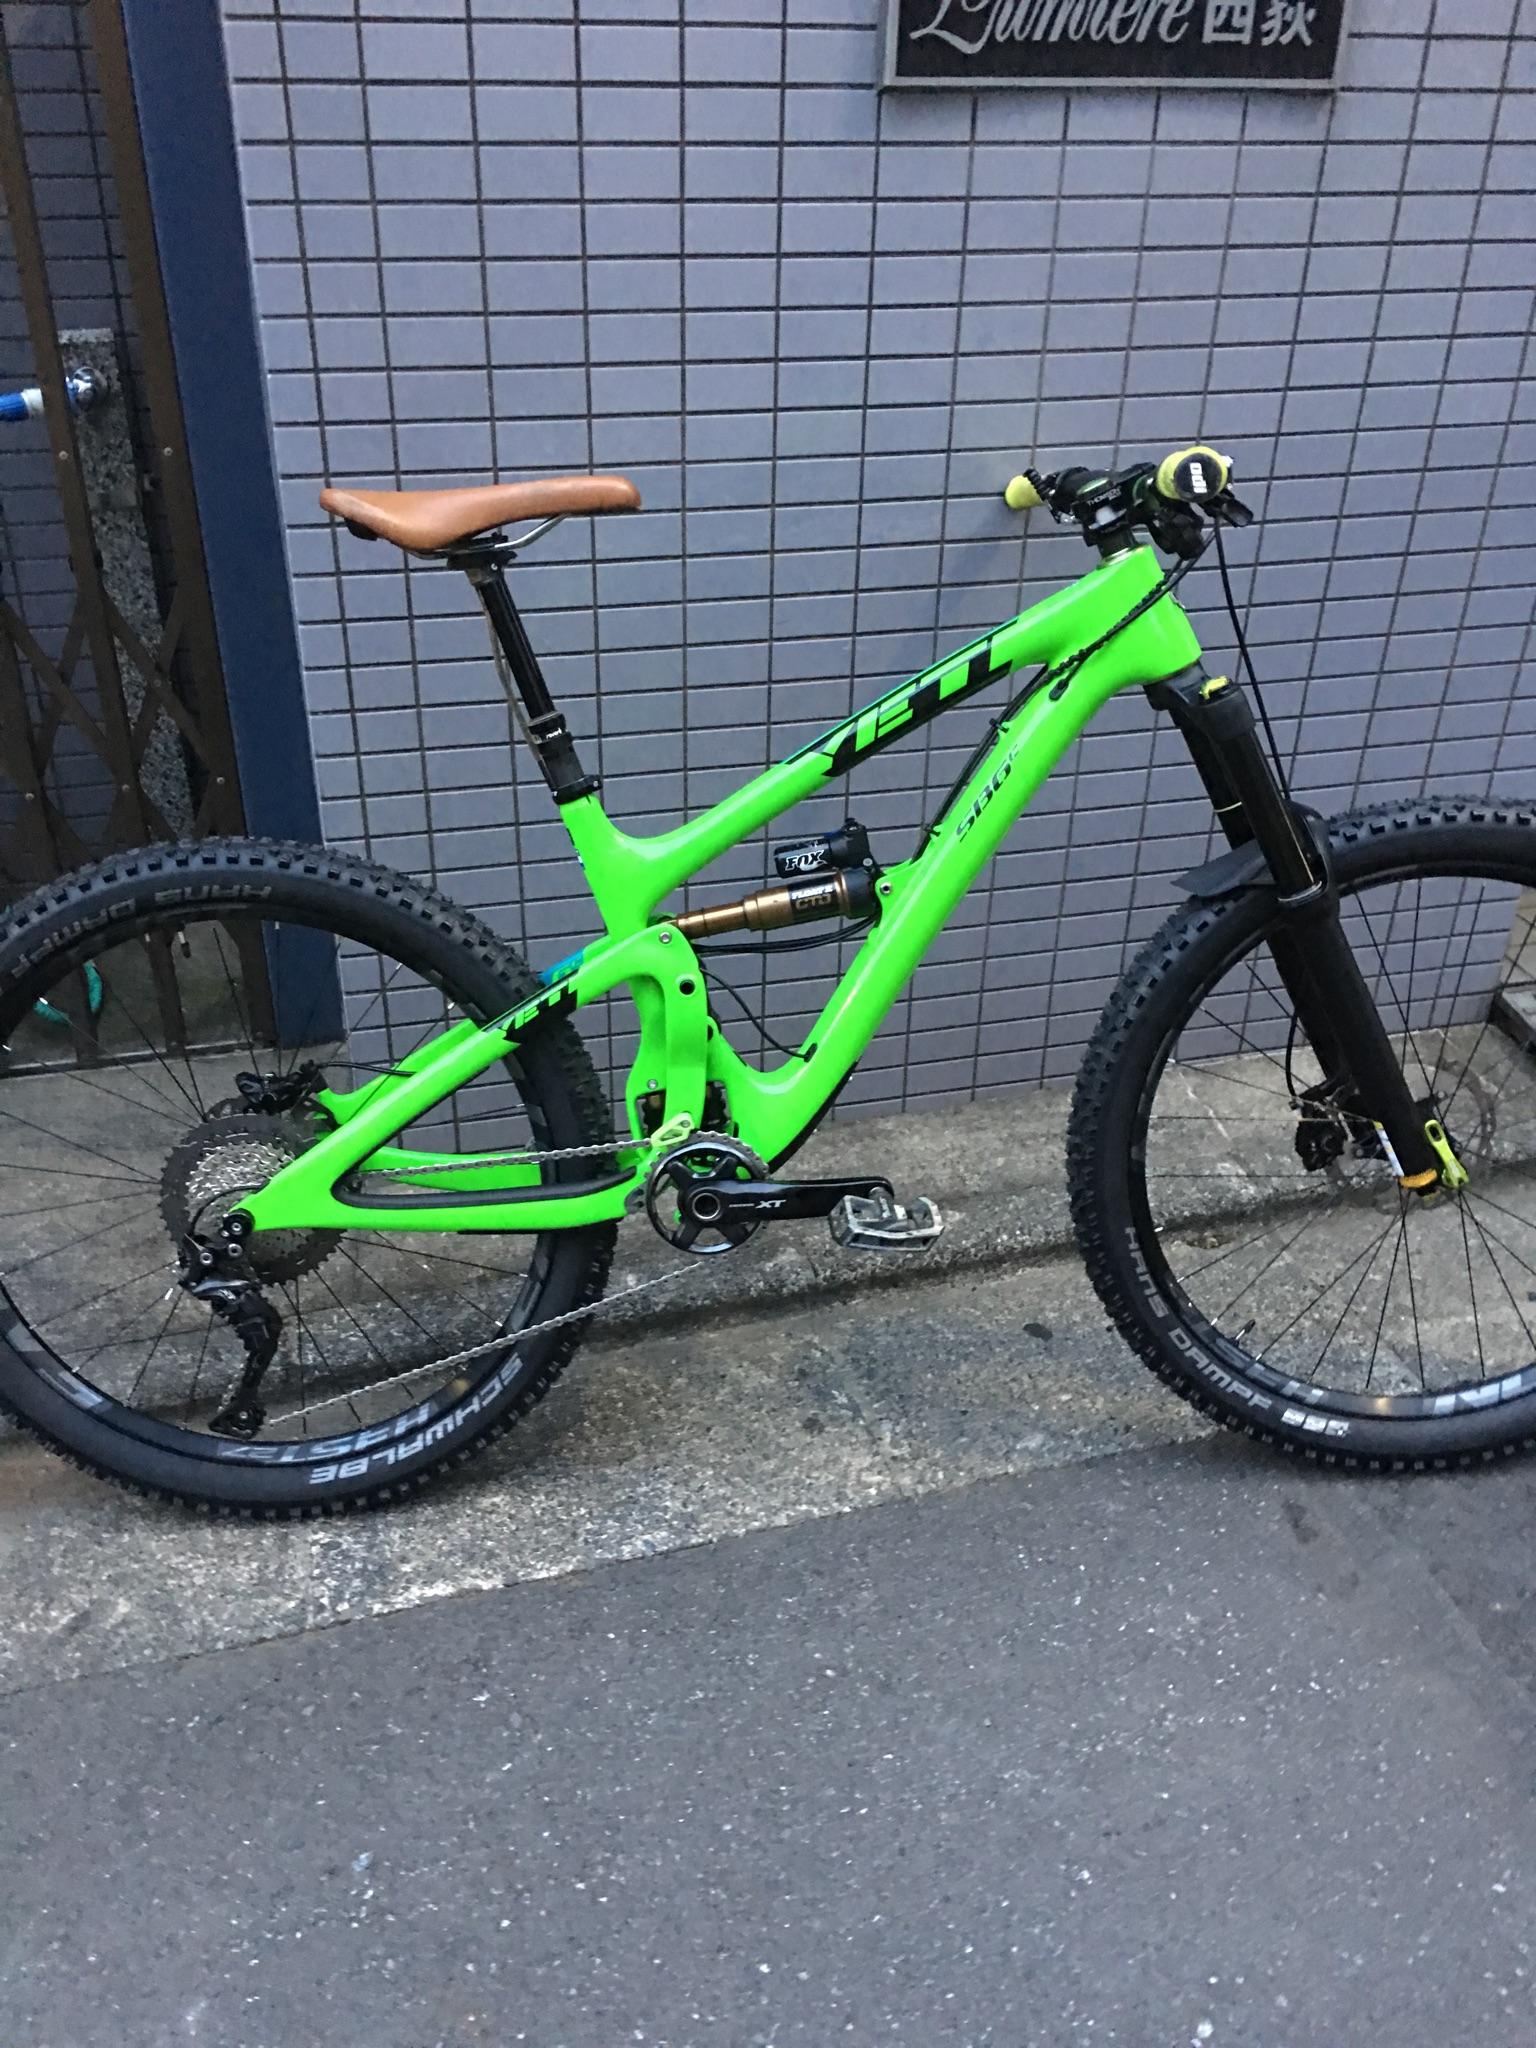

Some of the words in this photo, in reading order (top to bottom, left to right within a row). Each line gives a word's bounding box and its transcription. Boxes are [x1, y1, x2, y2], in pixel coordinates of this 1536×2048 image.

[785, 849, 828, 872] FOX
[755, 1199, 787, 1209] XT
[1124, 1225, 1169, 1318] HANS
[1167, 1326, 1272, 1410] DAMPF
[309, 1352, 524, 1485] SCHWALBE
